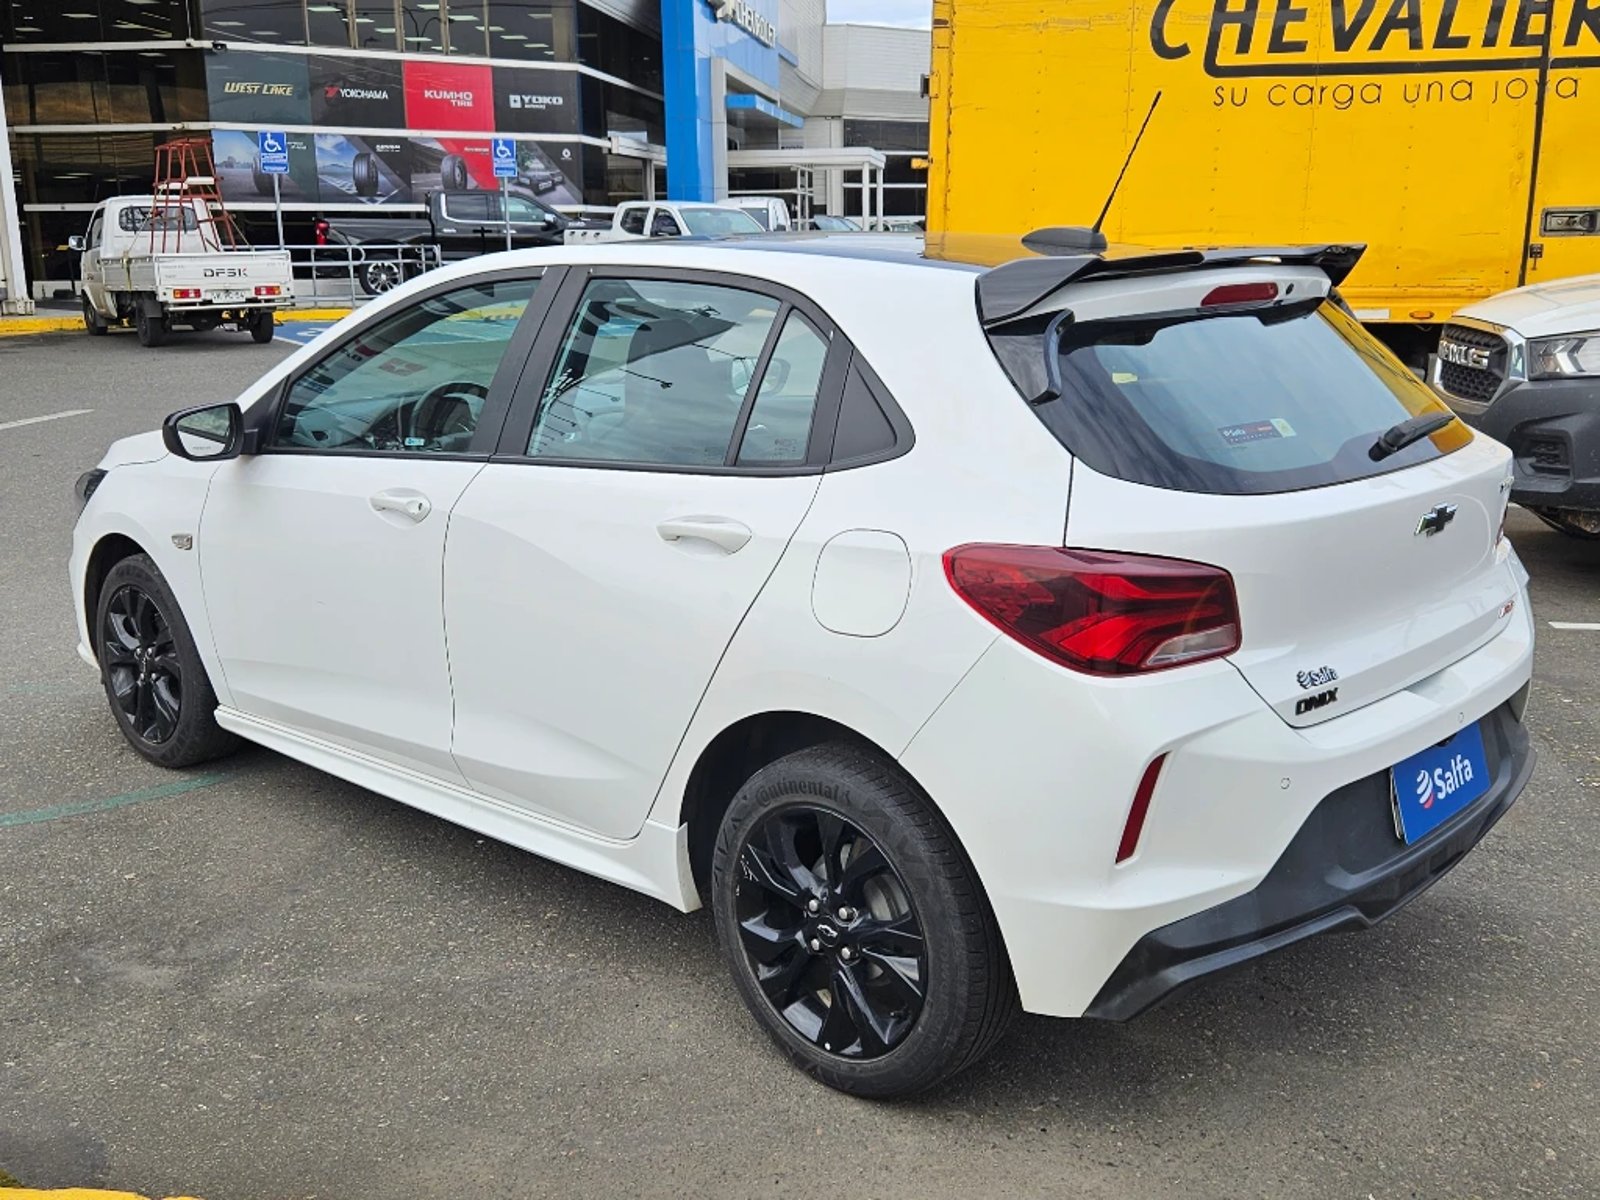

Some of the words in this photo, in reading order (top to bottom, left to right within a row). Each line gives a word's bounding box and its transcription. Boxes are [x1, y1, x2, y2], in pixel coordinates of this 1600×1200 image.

[224, 82, 261, 95] WEST
[262, 83, 294, 96] LAKE
[340, 89, 389, 100] YOKOHAMA
[424, 89, 474, 100] KUMHO
[1213, 85, 1248, 107] su
[1267, 82, 1382, 110] carga
[1403, 79, 1472, 103] una
[451, 100, 474, 108] TIRE
[521, 94, 564, 106] YOKO
[203, 268, 248, 278] DFSK
[1309, 666, 1339, 687] Salfa
[1295, 687, 1339, 716] ONIX
[1433, 753, 1474, 800] Salfa
[755, 778, 843, 808] Continental
